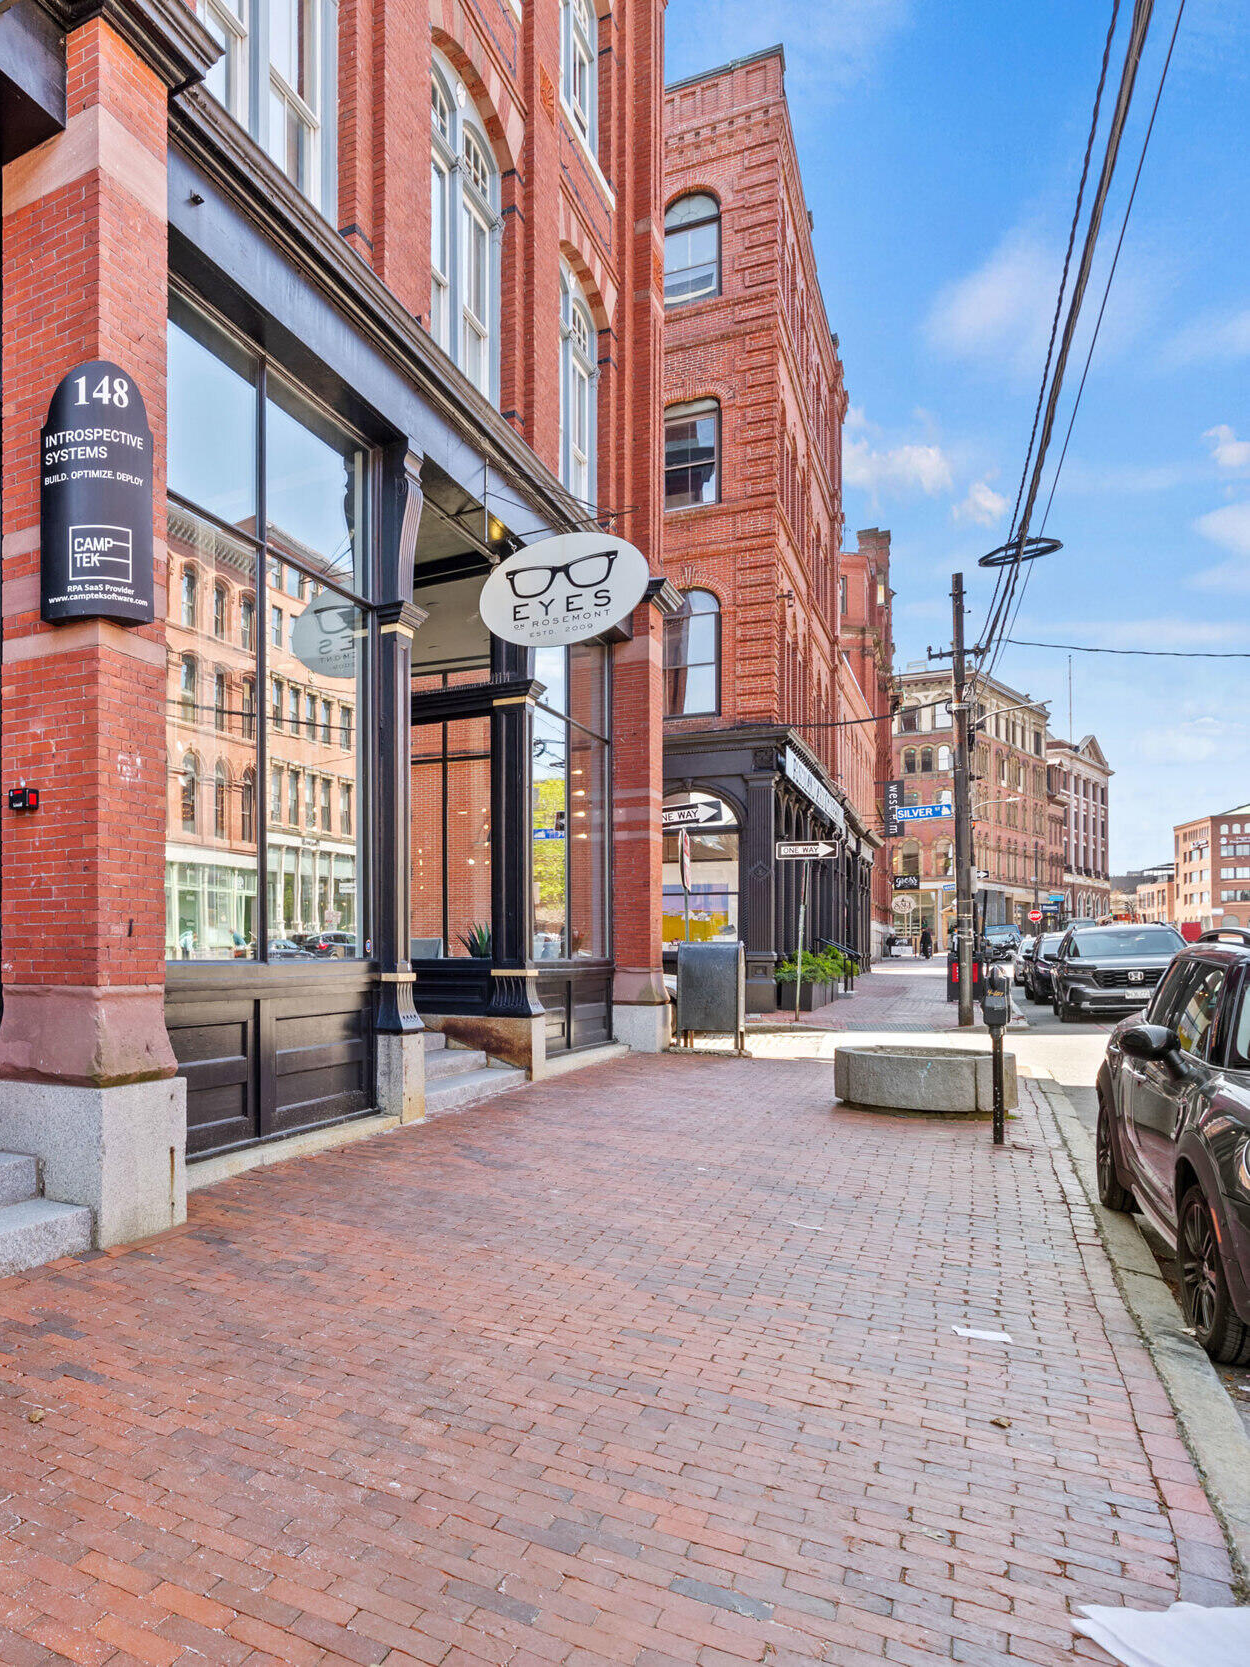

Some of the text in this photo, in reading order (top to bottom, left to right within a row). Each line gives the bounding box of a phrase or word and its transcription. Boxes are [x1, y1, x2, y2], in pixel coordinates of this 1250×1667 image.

[73, 375, 130, 409] 148
[45, 428, 144, 450] INTROSPECTIVE
[45, 446, 108, 466] SYSTEMS
[44, 469, 144, 487] BUILD. OPTIMIZE. DEPLOY
[74, 537, 114, 552] CAMP
[74, 553, 100, 568] TEK
[67, 583, 135, 595] RPA SaaS Provider
[48, 592, 148, 608] www.campteksoftware.com
[512, 589, 612, 622] EYES
[532, 608, 611, 628] ROSEMONT
[565, 623, 595, 633] 2009
[888, 784, 899, 811] west
[662, 809, 699, 822] NE WAY
[897, 807, 933, 819] SILVER
[782, 845, 819, 855] ONE WAY
